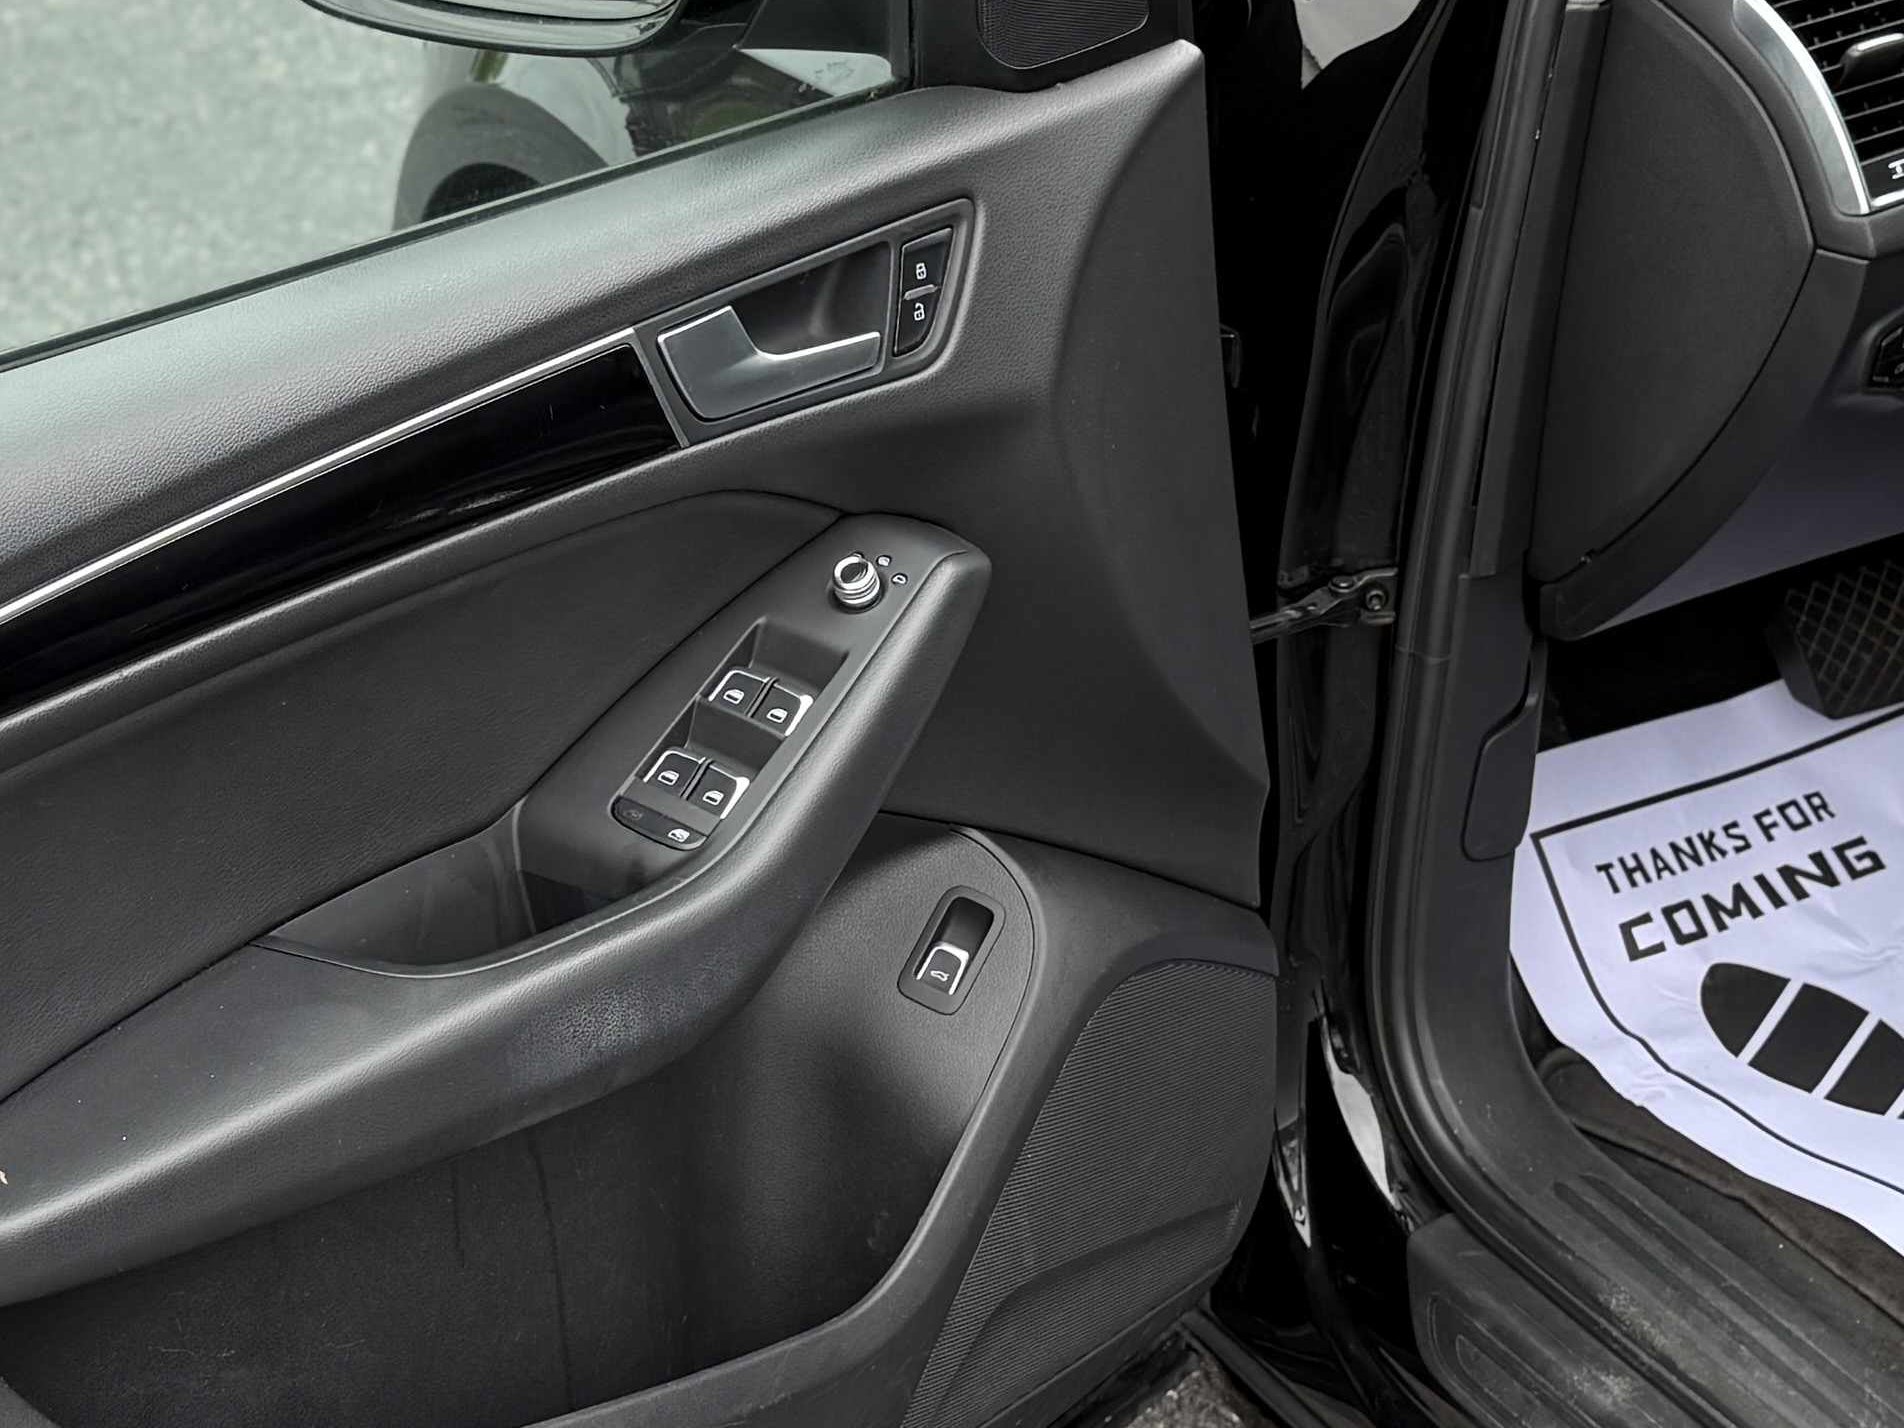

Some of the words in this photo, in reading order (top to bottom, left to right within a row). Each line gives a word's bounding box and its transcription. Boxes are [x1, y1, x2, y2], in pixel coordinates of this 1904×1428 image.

[1595, 820, 1753, 894] THANKS
[1752, 790, 1836, 843] FOR
[1618, 835, 1887, 963] COMING
